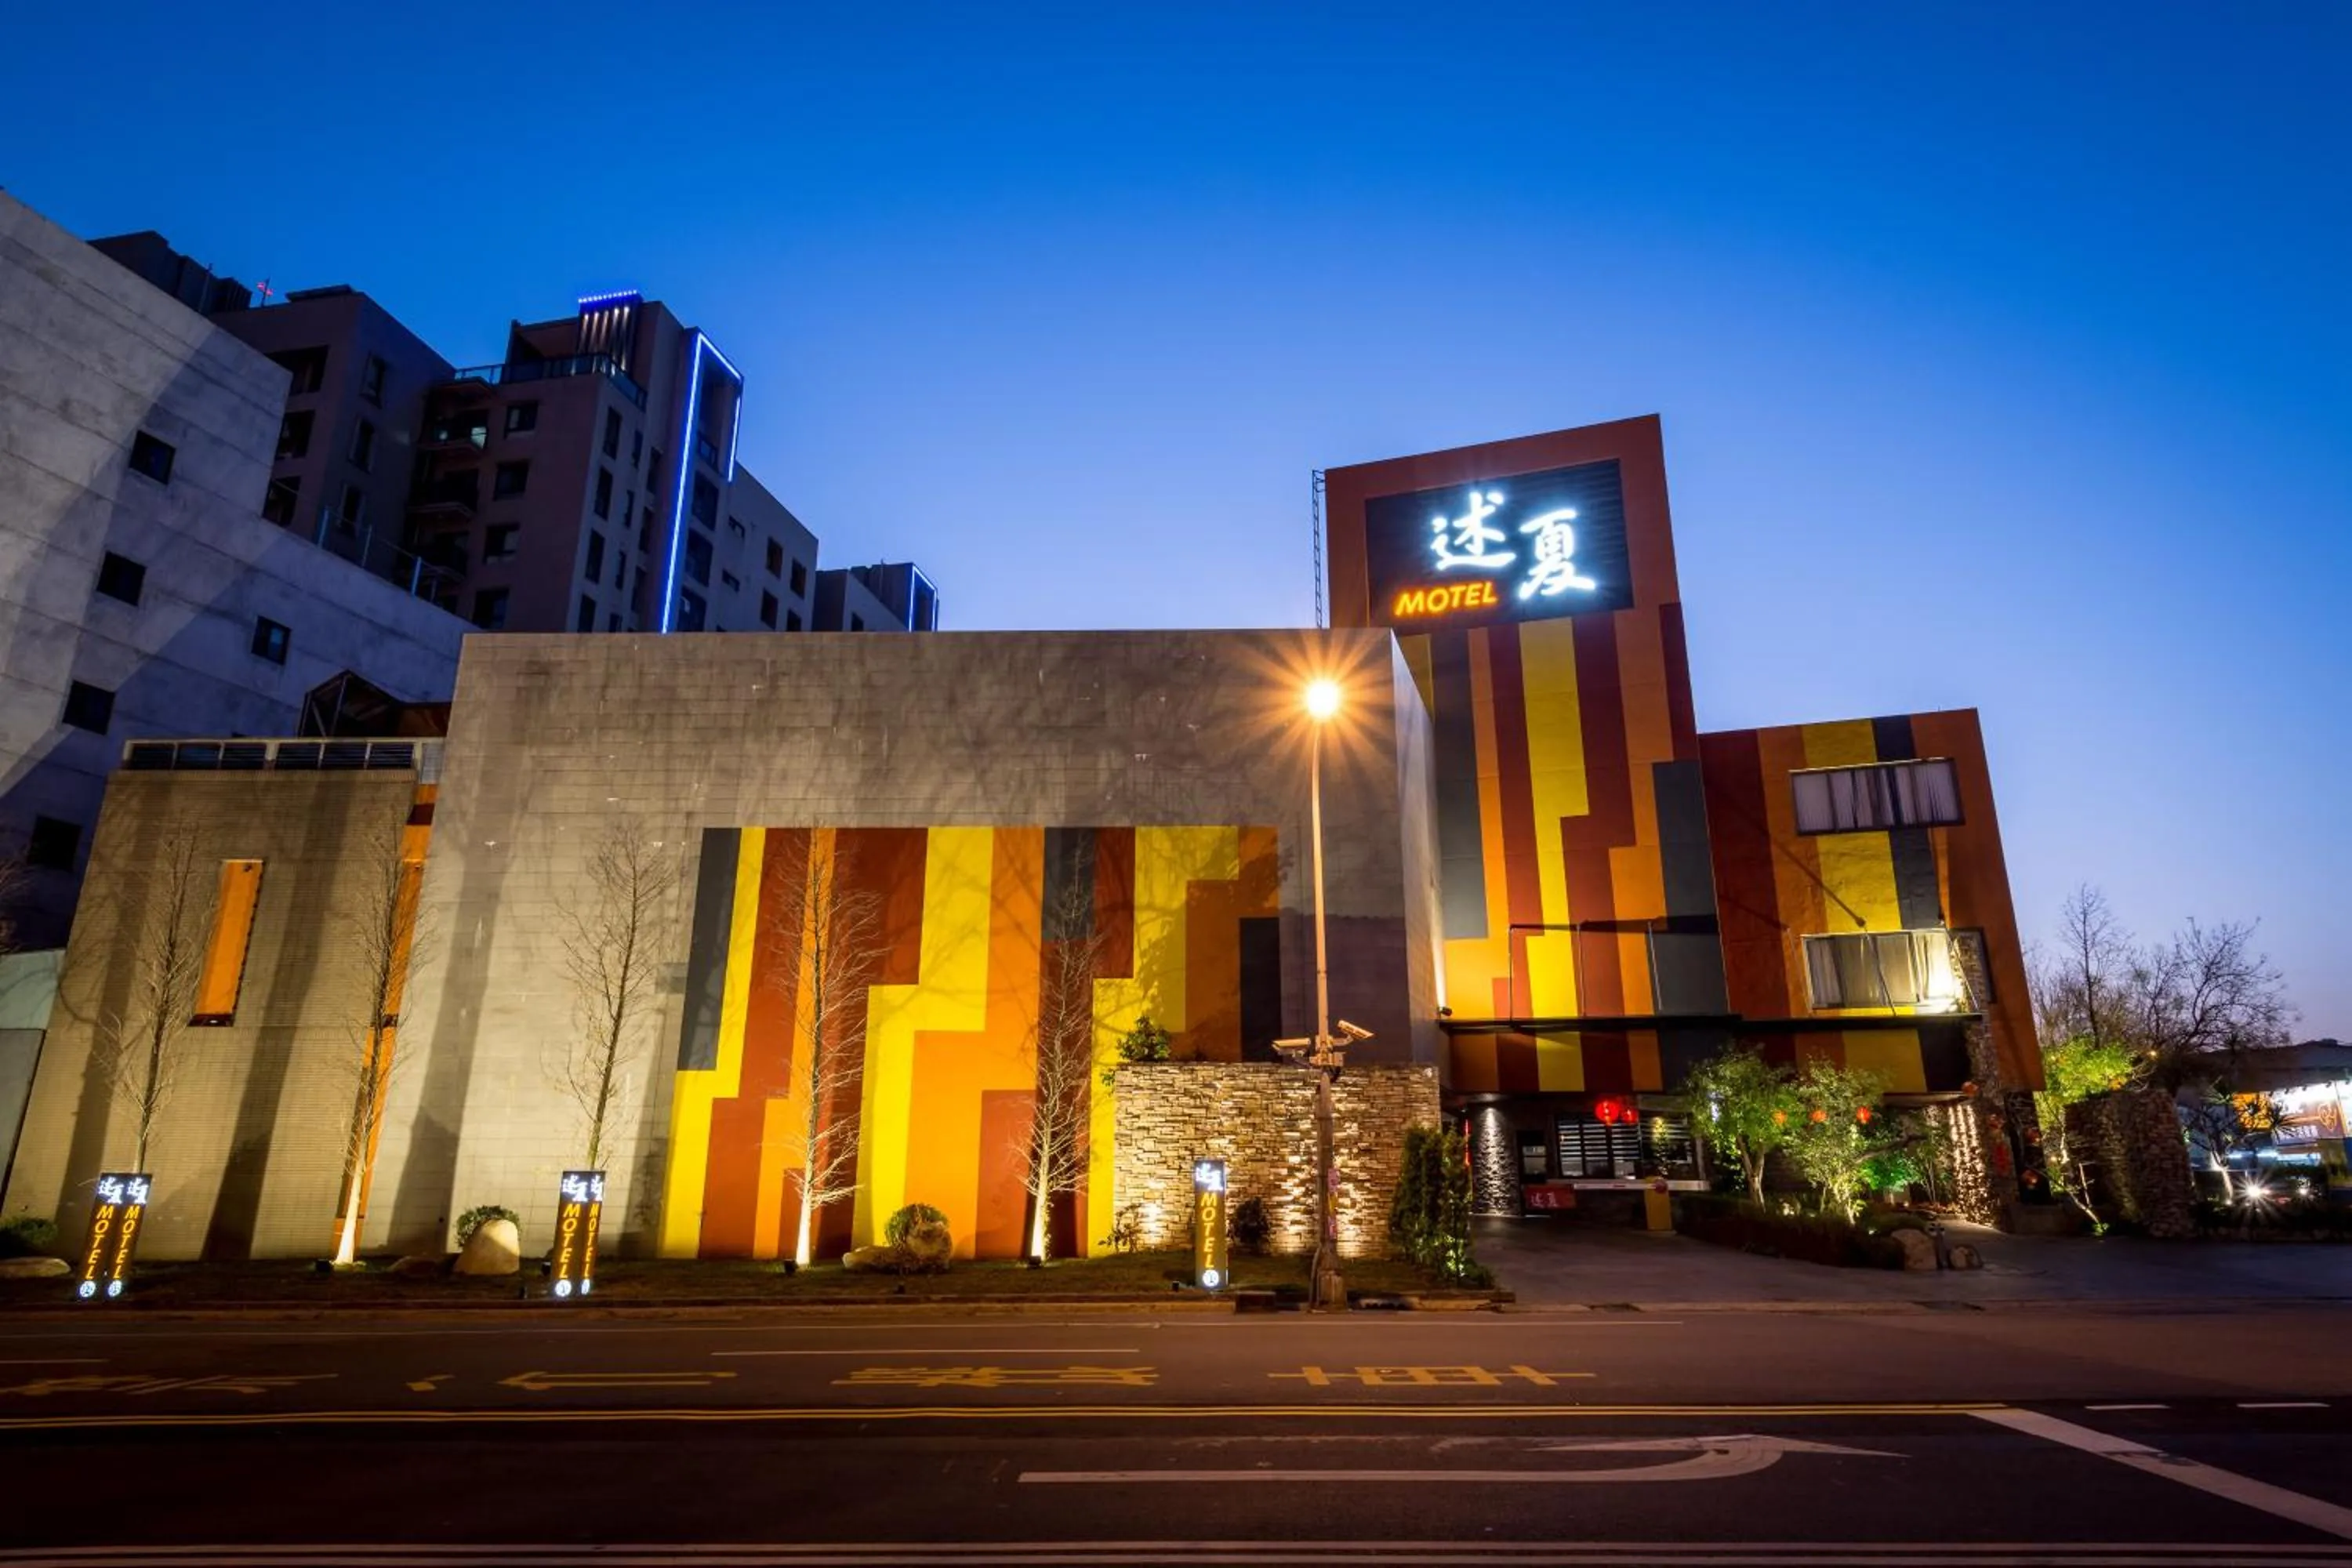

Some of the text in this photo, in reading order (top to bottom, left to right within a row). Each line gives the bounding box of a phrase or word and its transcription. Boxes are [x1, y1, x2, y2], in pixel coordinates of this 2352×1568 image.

[1394, 581, 1499, 616] MOTEL
[85, 1205, 114, 1280] MOTEL
[112, 1205, 140, 1279] MOTEL
[558, 1203, 581, 1279] MOTEL
[584, 1203, 600, 1279] MOTEL
[1200, 1192, 1218, 1269] MOTEL
